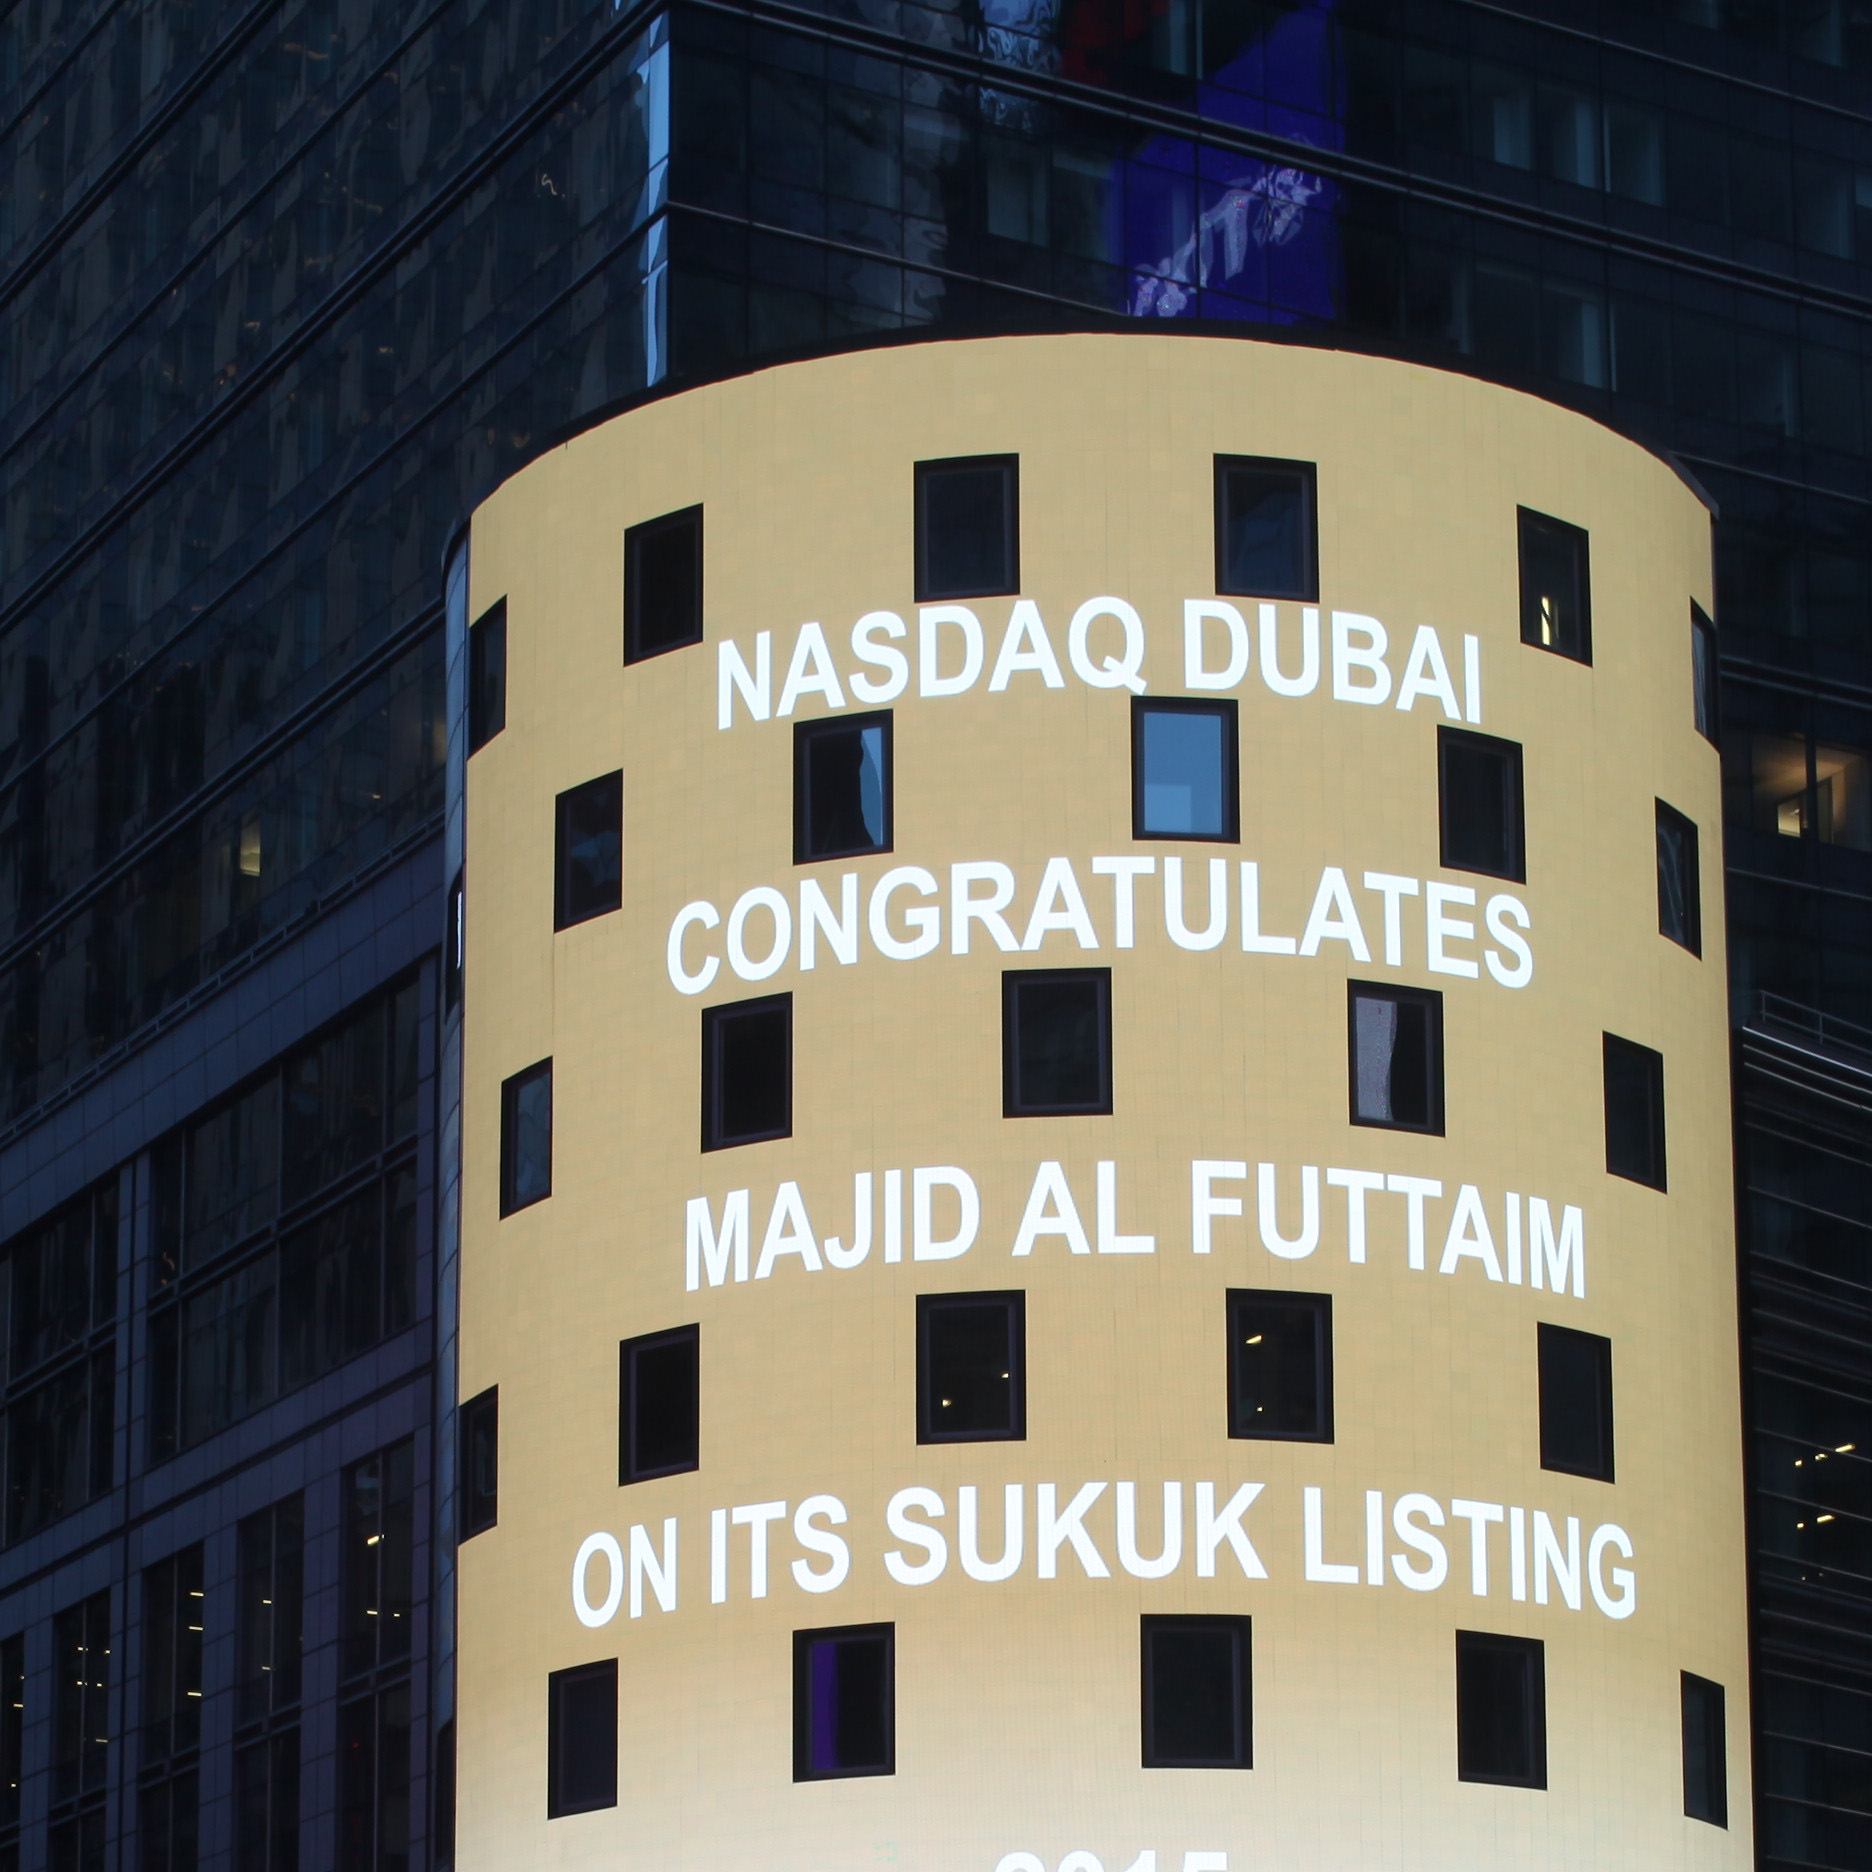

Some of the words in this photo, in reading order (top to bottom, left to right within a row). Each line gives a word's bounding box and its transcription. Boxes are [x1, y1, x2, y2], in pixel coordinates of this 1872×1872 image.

[716, 594, 1148, 730] NASDAQ
[1184, 598, 1481, 724] DUBAI
[666, 854, 1534, 998] CONGRATULATES
[684, 1164, 980, 1292] MAJID
[1011, 1160, 1156, 1258] AL
[1191, 1158, 1587, 1300] FUTTAIM
[572, 1517, 680, 1628] ON
[710, 1494, 852, 1604] ITS
[884, 1480, 1268, 1588] SUKUK
[1302, 1484, 1637, 1620] LISTING
